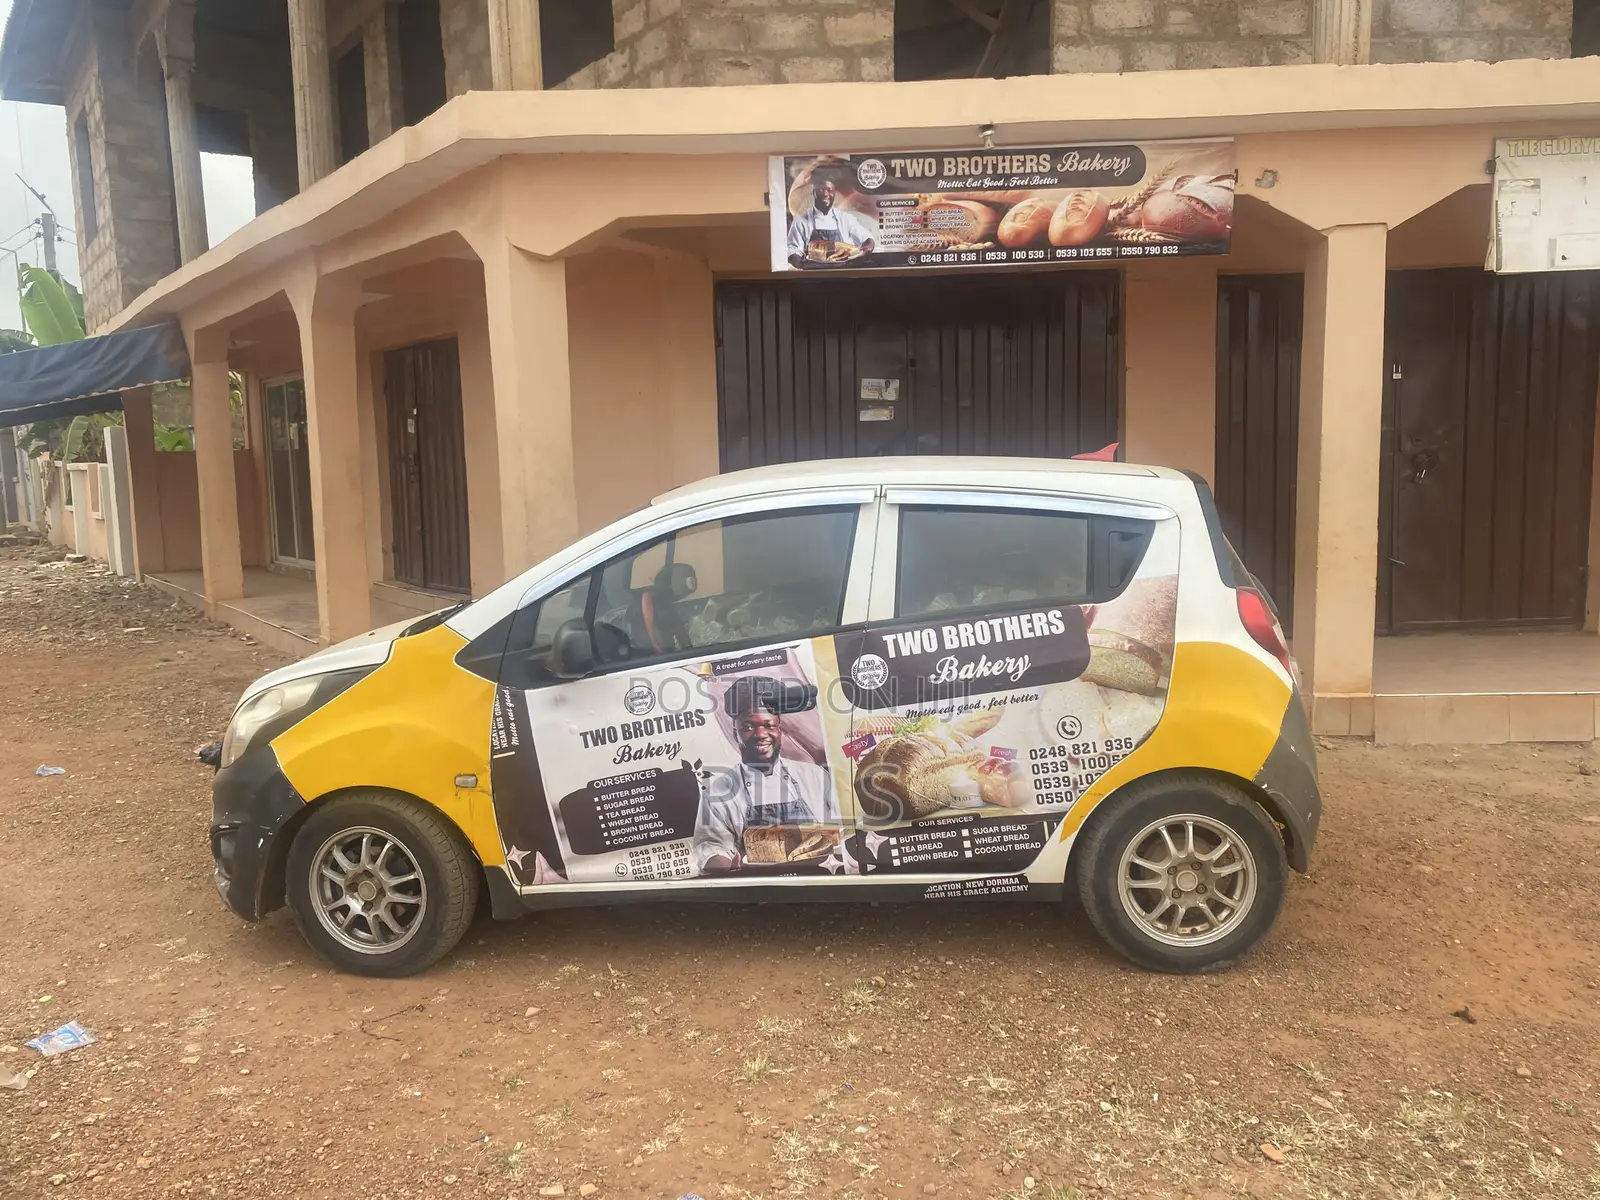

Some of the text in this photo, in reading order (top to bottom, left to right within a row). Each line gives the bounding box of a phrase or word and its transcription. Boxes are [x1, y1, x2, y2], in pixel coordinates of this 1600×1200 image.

[1507, 139, 1538, 157] THE
[1541, 137, 1592, 156] GLORY
[891, 150, 1132, 178] TWO BROTHERS Bakery
[937, 179, 965, 189] Motto:
[966, 178, 981, 188] Eat
[1010, 176, 1028, 187] Feel
[1030, 175, 1058, 185] Better
[920, 245, 1179, 263] 0248 821 936 0539 100 530 0539 103 655 0550 790 832
[882, 609, 1066, 659] TWO BROTHERS
[722, 662, 737, 670] treat
[737, 660, 746, 668] for
[747, 657, 765, 665] every
[862, 659, 876, 667] TWO
[929, 653, 1032, 685] Bakery
[938, 704, 955, 715] eat
[988, 695, 1008, 708] feel
[1010, 692, 1040, 705] better
[506, 708, 515, 721] eat
[496, 717, 505, 729] HIS
[579, 708, 706, 749] TWO BROTHERS
[498, 729, 509, 749] NEAR
[612, 741, 683, 765] Bakery
[1029, 737, 1133, 760] 0248 821 936
[1031, 760, 1069, 775] 0539
[1080, 756, 1107, 770] 100
[593, 769, 657, 789] OUR SERVICES
[1033, 775, 1071, 790] 0539
[600, 785, 656, 801] BUTTER BREAD
[1035, 790, 1074, 805] 0550
[603, 794, 655, 810] SUGAR BREAD
[605, 805, 646, 819] TEA BREAD
[607, 812, 659, 828] WHEAT BREAD
[610, 820, 664, 837] BROWN BREAD
[918, 815, 974, 828] OUR SERVICES
[972, 823, 1028, 836] SUGAR BREAD
[612, 827, 675, 845] COCONUT BREAD
[899, 830, 957, 844] BUTTER BREAD
[974, 833, 1030, 845] WHEAT BREAD
[628, 842, 686, 859] 0248 821 936
[900, 842, 943, 854] TEA BREAD
[974, 841, 1041, 855] COCONUT BREAD
[630, 848, 690, 867] 0539 100 530
[902, 850, 959, 864] BROWN BREAD
[631, 857, 689, 876] 0539 103 655
[634, 866, 691, 881] 0550 790 832
[965, 881, 985, 889] NEW
[986, 877, 1020, 886] DORMAA
[923, 884, 1029, 899] NEAR HIS GRACE ACADEMY
